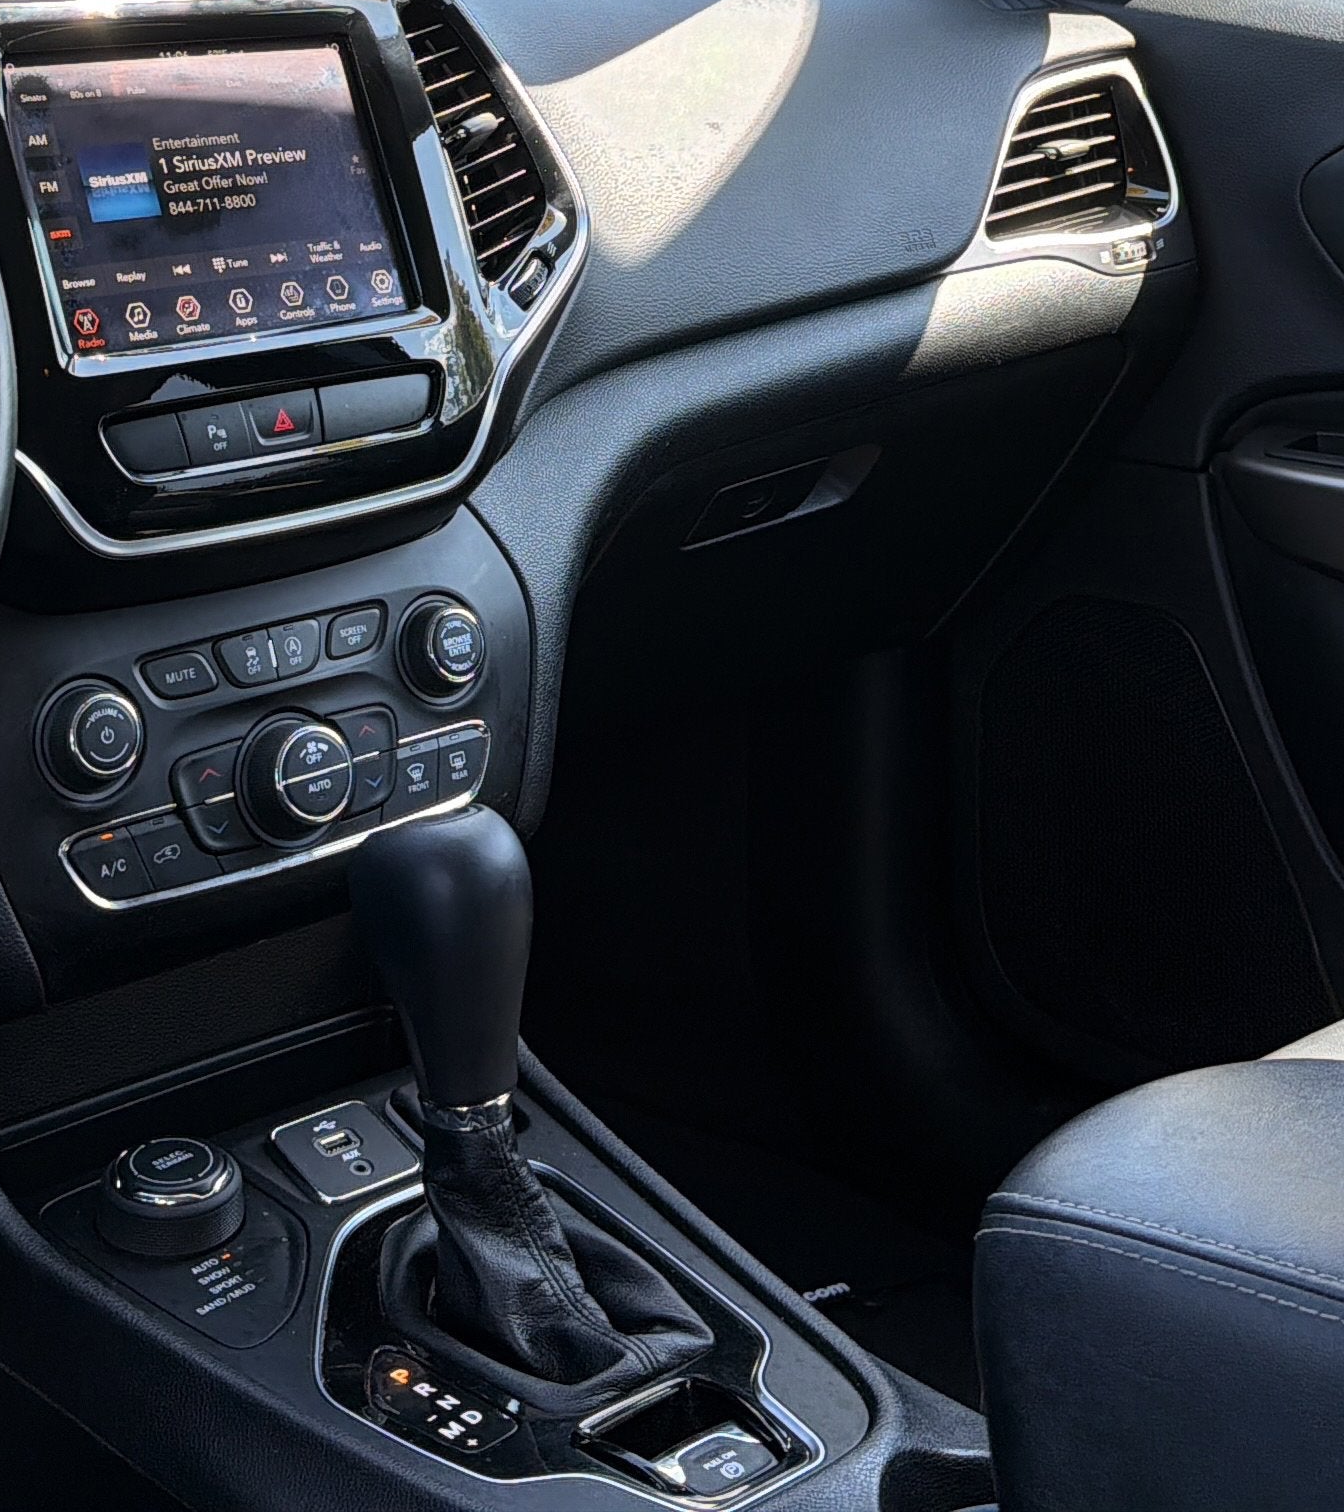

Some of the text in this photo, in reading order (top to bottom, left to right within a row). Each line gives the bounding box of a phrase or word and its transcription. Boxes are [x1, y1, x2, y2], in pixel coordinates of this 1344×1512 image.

[28, 135, 48, 146] AM
[152, 133, 240, 150] Entertainment
[158, 147, 306, 174] 1 SiriusXM Preview
[88, 171, 148, 188] SiriusXM
[163, 172, 269, 194] Great Offer Now!
[39, 182, 58, 193] FM
[169, 194, 256, 216] 844-711-8800
[307, 242, 333, 252] Traffic
[359, 242, 383, 252] Audio
[227, 258, 249, 268] Tune
[309, 252, 343, 263] Weather
[62, 278, 96, 289] Browse
[116, 271, 146, 284] Replay
[330, 301, 356, 312] Phone
[370, 295, 404, 308] Settings
[279, 307, 315, 320] Controls
[235, 316, 258, 327] Apps
[176, 323, 211, 335] Climate
[129, 330, 158, 342] Media
[78, 338, 106, 349] Radio
[213, 441, 228, 452] OFF
[339, 624, 367, 637] SCREEN
[348, 635, 362, 646] OFF
[443, 634, 473, 647] BROWSE
[448, 646, 471, 656] ENTER
[289, 656, 303, 665] OFF
[451, 660, 473, 670] SCROLL
[165, 668, 197, 684] MUTE
[248, 664, 262, 675] OFF
[88, 707, 118, 723] VOLUME
[306, 754, 323, 765] OFF
[452, 770, 469, 780] REAR
[308, 779, 332, 793] AUTO
[408, 780, 430, 794] FRONT
[100, 859, 127, 878] A/C
[341, 1149, 362, 1162] AUX
[190, 1258, 220, 1275] AUTO
[197, 1266, 231, 1286] SNOW
[209, 1274, 244, 1295] SPORT
[195, 1282, 257, 1316] SAND/MUD
[389, 1368, 409, 1385] P
[412, 1382, 438, 1397] R
[435, 1394, 461, 1410] N
[459, 1410, 483, 1425] D
[437, 1420, 467, 1440] M
[702, 1449, 739, 1470] PULL ON
